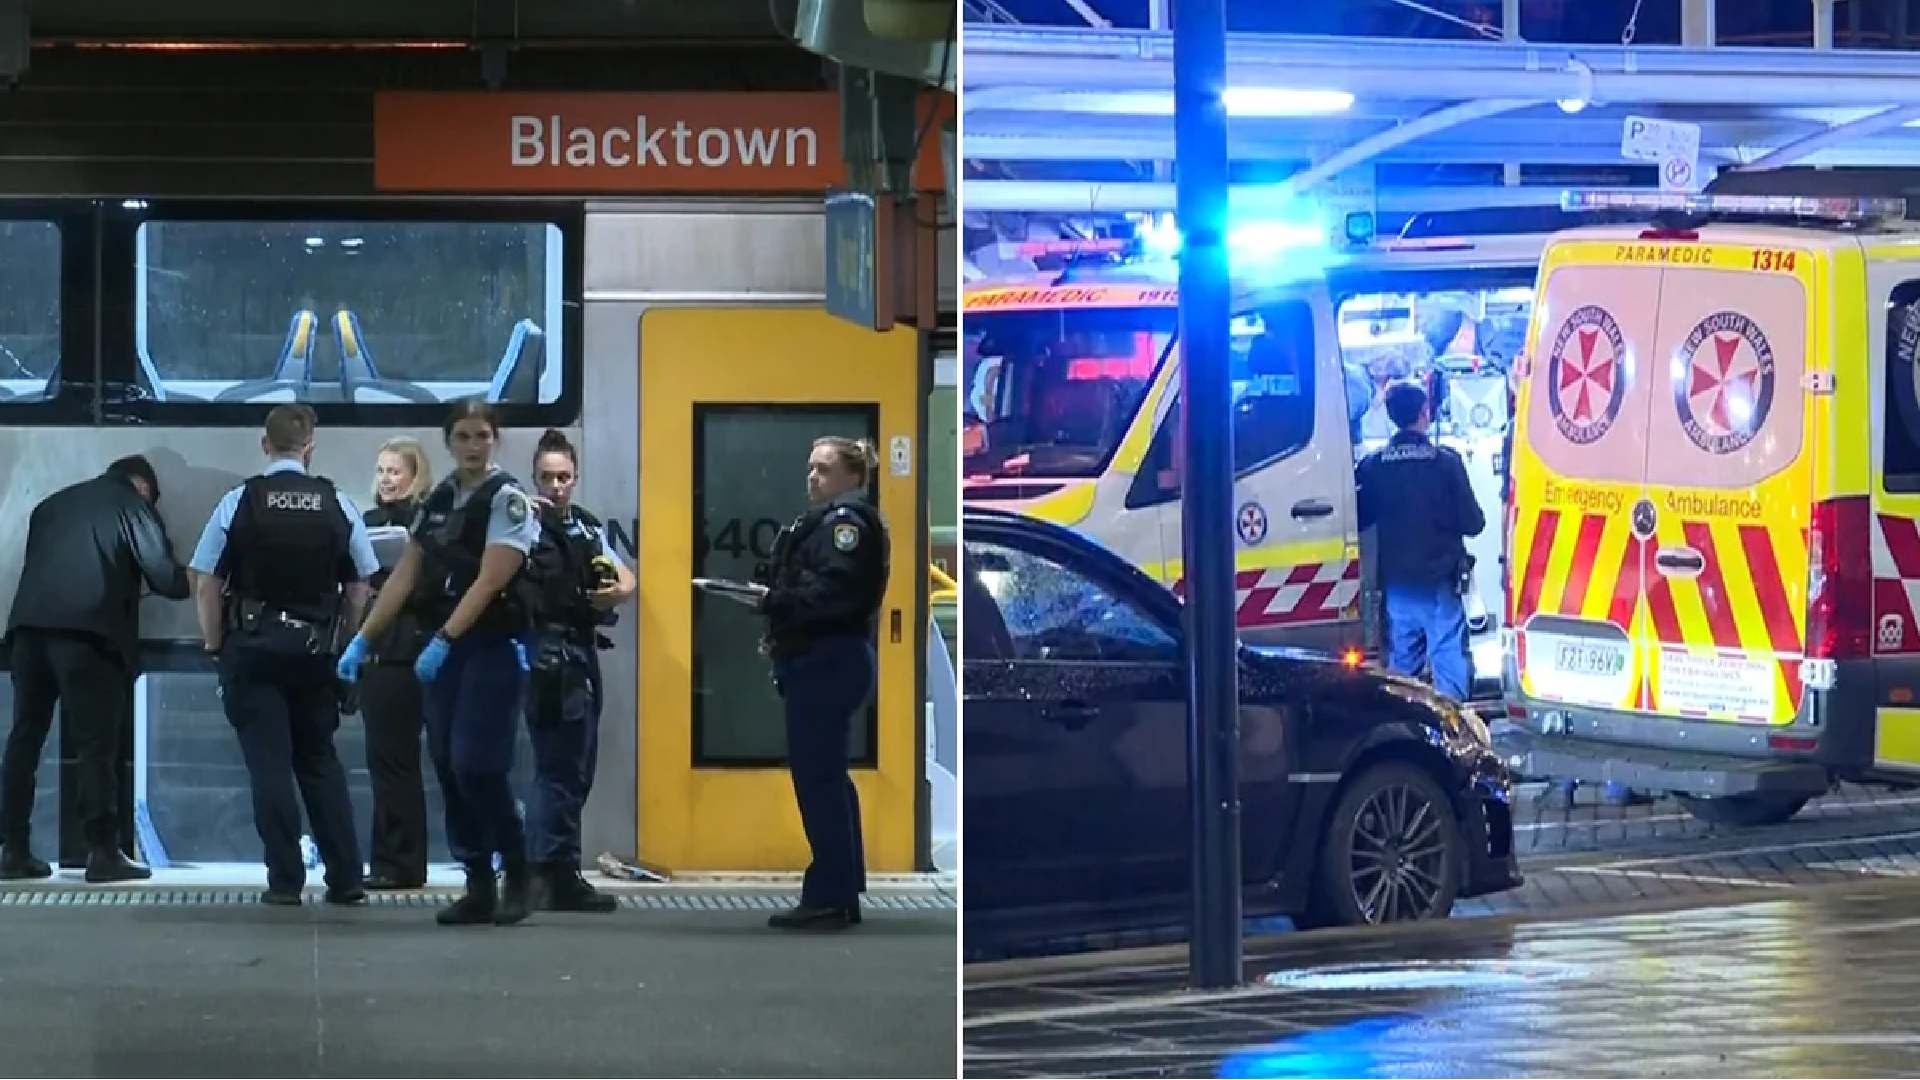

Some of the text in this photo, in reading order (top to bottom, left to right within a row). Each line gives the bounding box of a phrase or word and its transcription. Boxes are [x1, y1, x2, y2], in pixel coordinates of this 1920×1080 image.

[511, 114, 817, 167] Blacktown
[1631, 120, 1646, 139] P
[1615, 245, 1796, 272] PARAMEDIC 1314
[267, 492, 322, 511] POLICE
[1666, 490, 1761, 518] Ambulance
